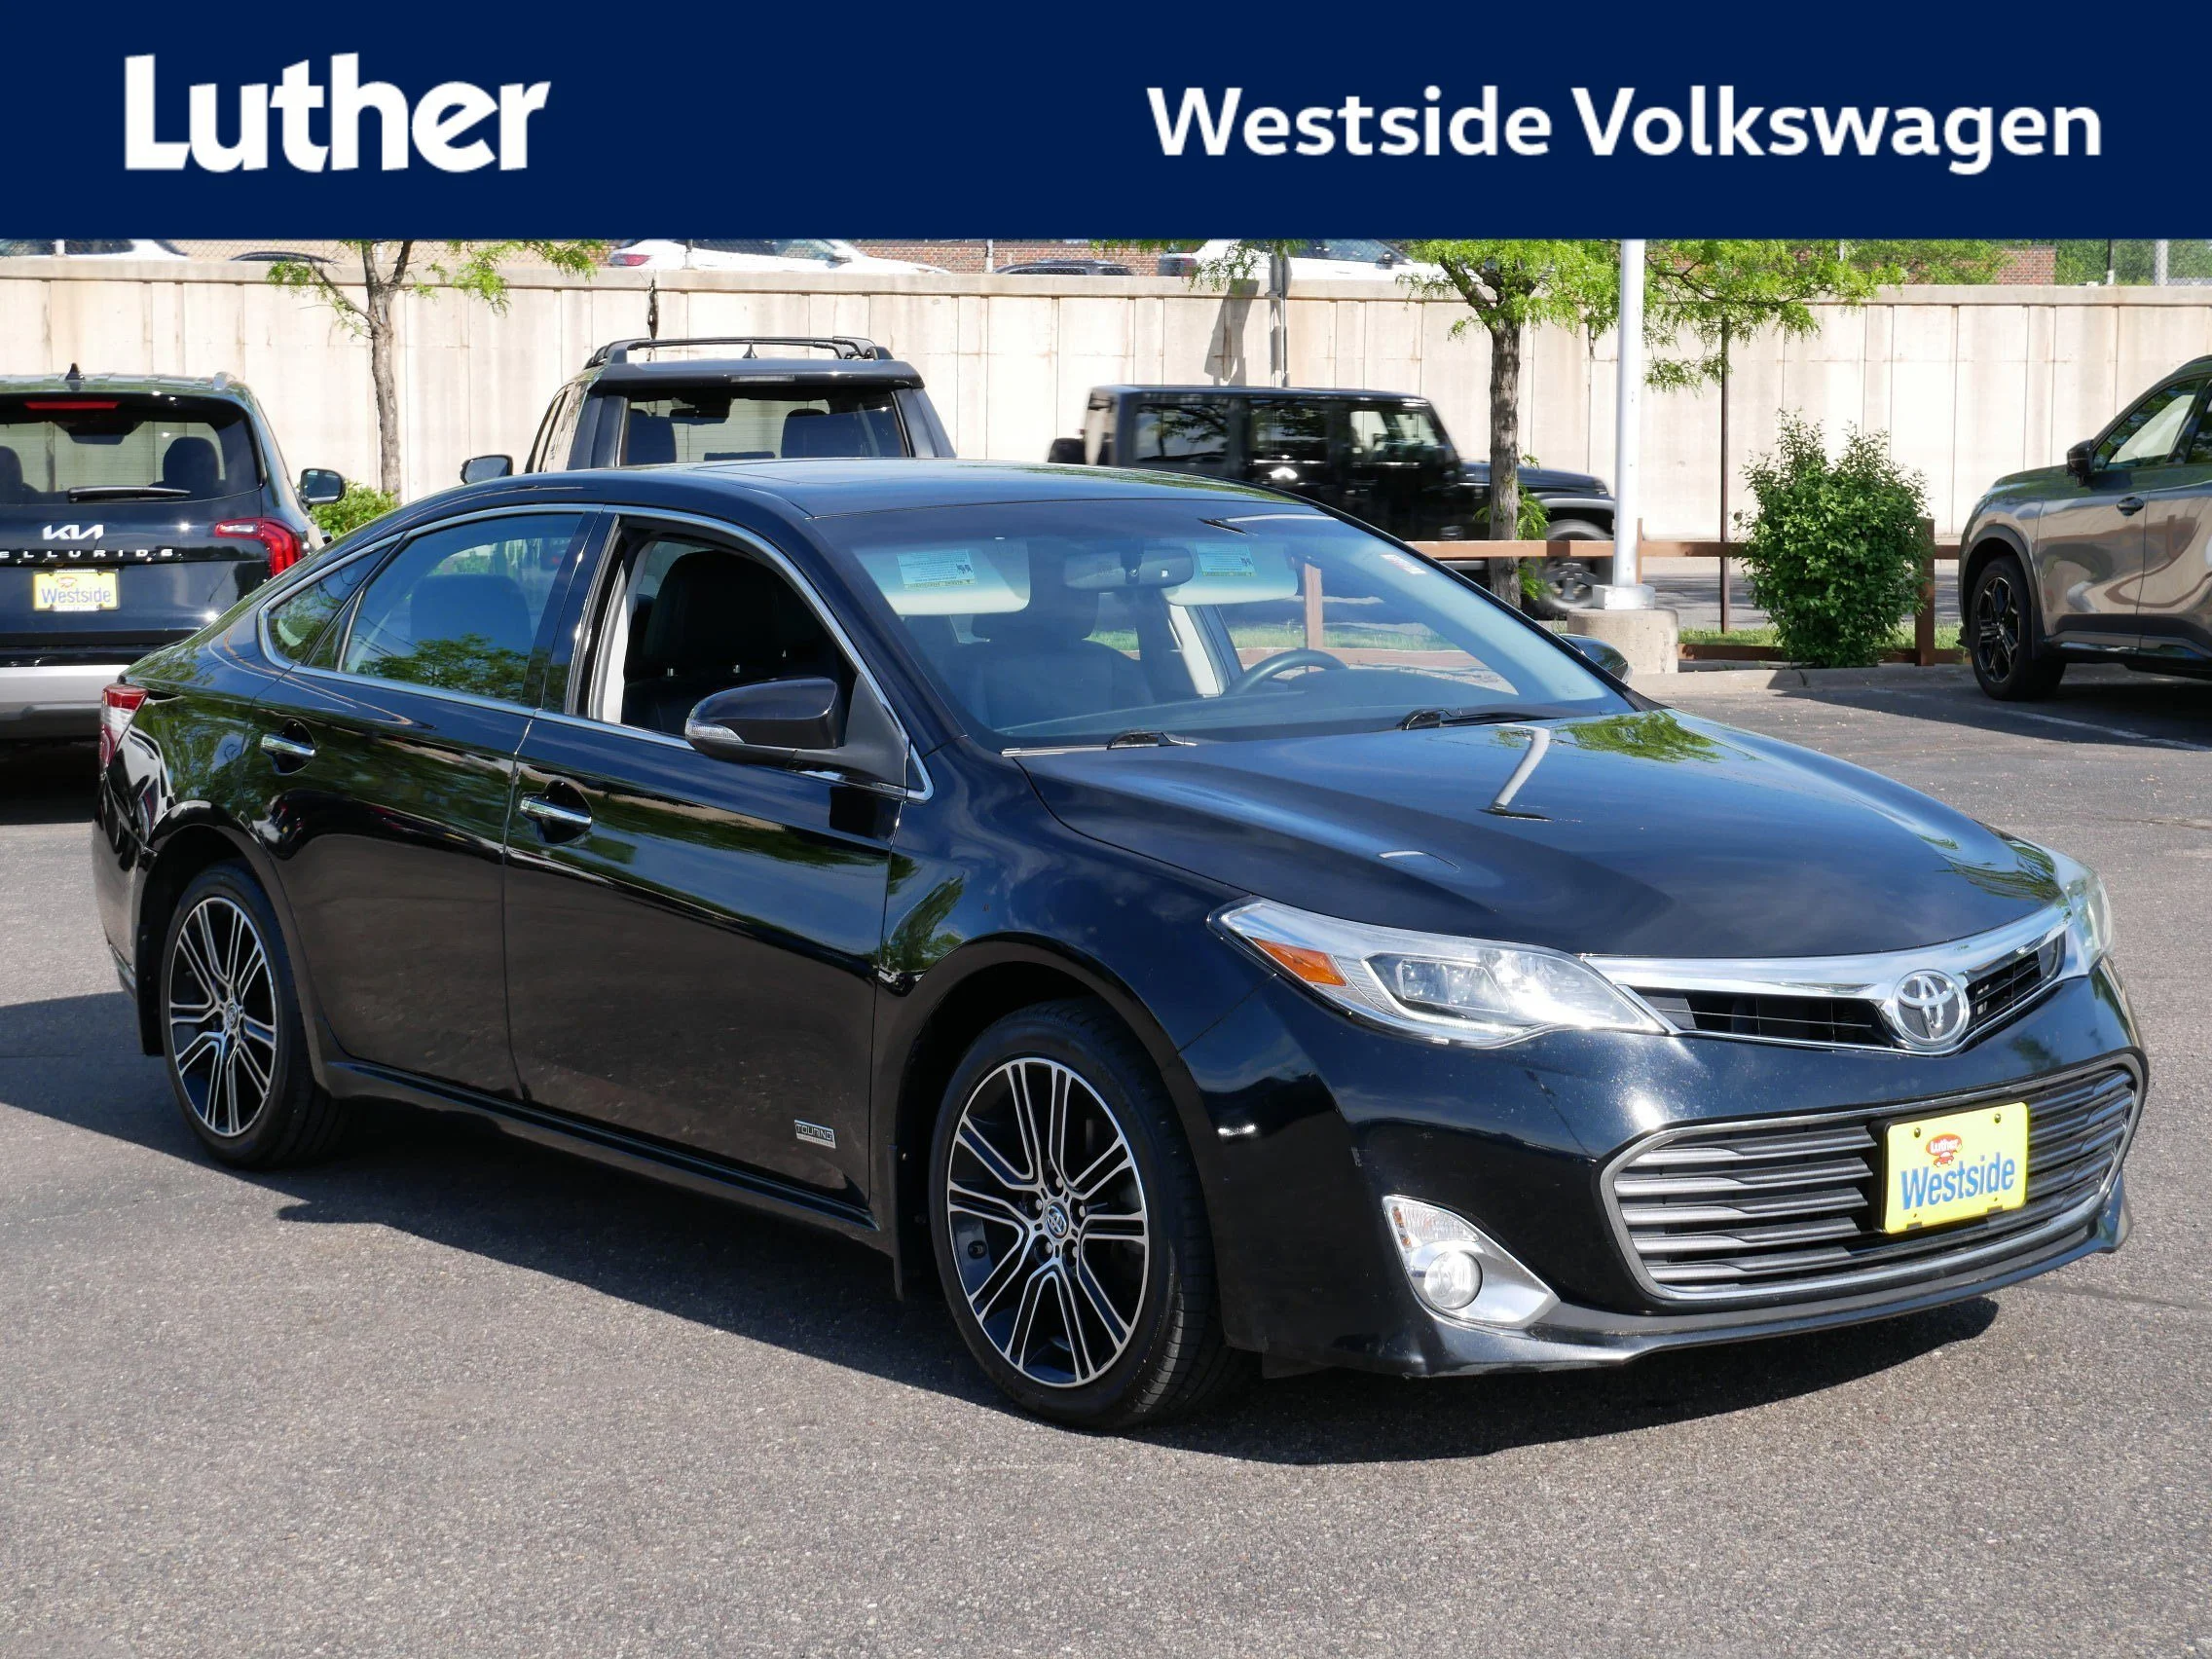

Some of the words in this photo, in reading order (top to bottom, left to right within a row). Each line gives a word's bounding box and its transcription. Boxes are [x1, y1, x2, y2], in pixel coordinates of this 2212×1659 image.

[42, 524, 104, 539] KIA
[41, 587, 112, 604] Westside
[1930, 1138, 1959, 1154] Luther
[1900, 1152, 2015, 1210] Westside
